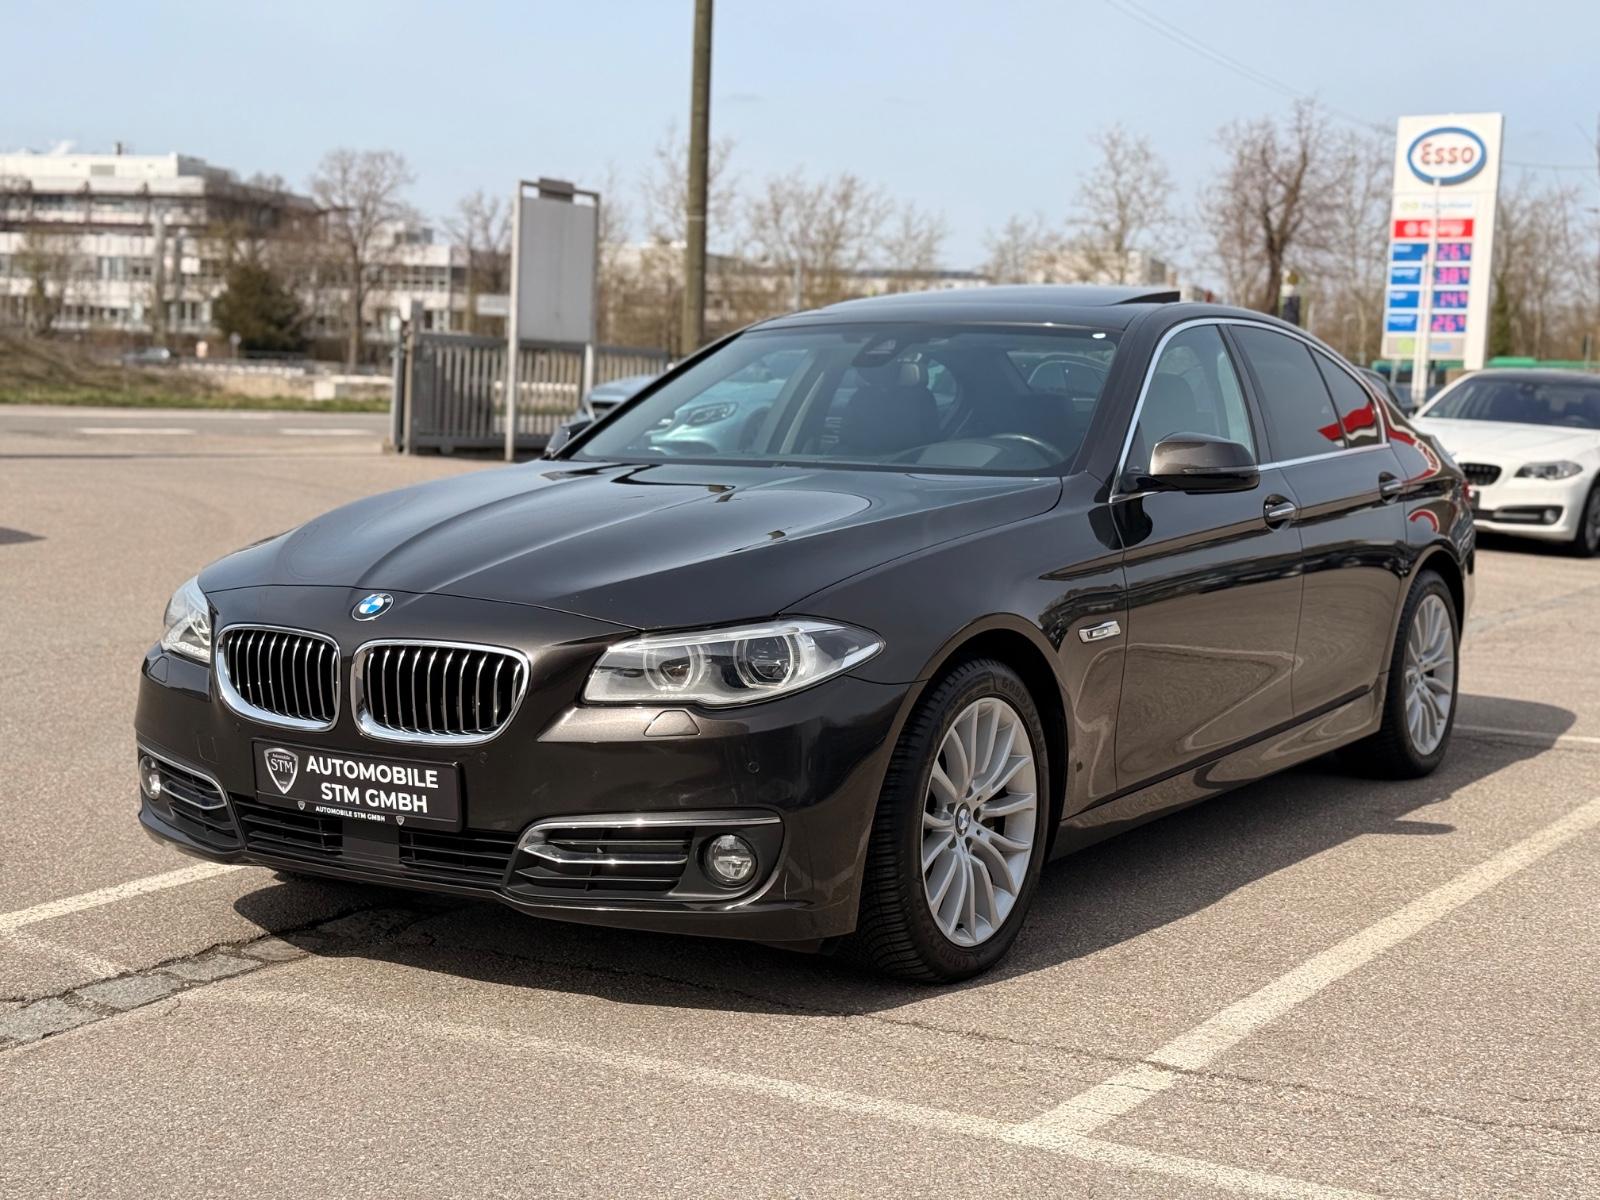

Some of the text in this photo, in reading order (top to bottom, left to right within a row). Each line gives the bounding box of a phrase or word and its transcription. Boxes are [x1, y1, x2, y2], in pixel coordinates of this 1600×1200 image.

[1421, 142, 1474, 165] Esso
[270, 758, 294, 774] STM
[306, 755, 439, 788] AUTOMOBILE
[321, 782, 428, 813] STM GMBH
[315, 806, 386, 822] AUTOMOBILE STM GMBH
